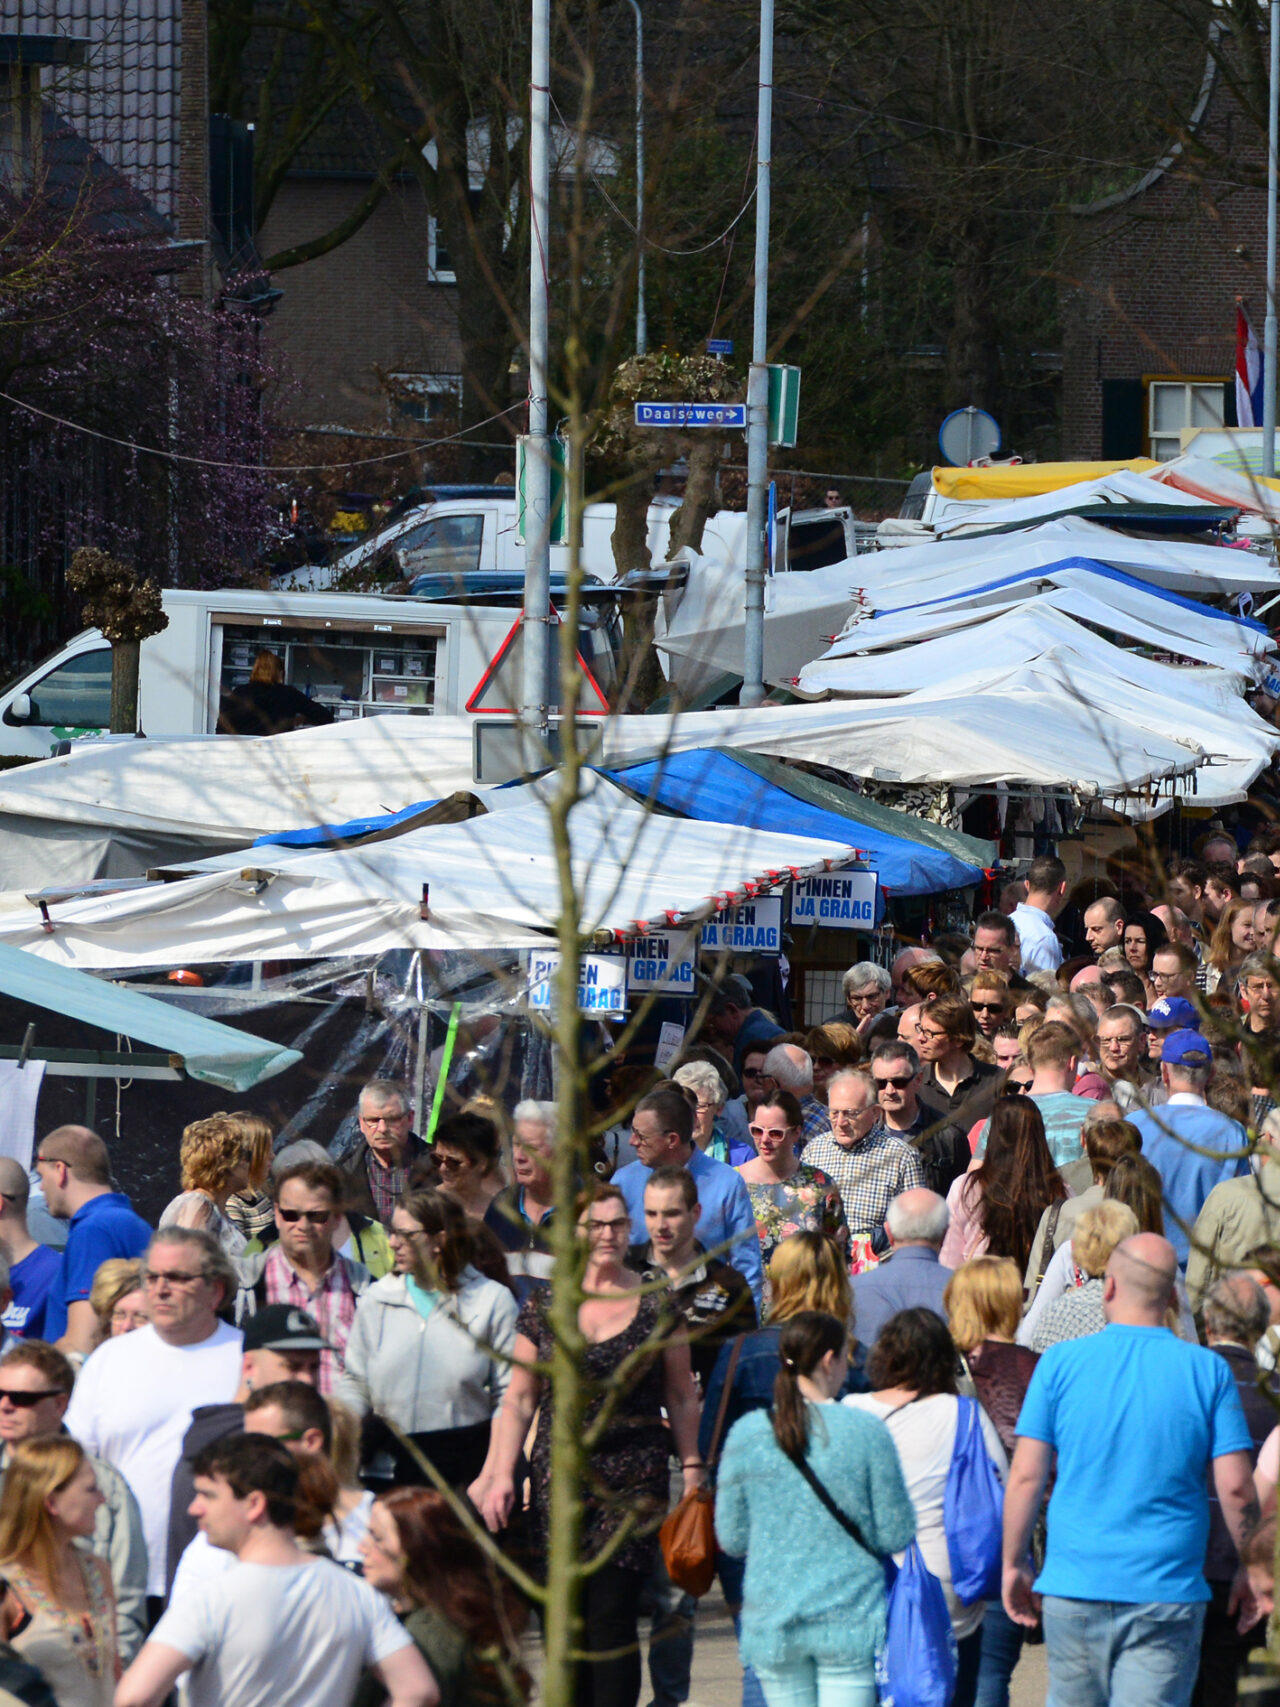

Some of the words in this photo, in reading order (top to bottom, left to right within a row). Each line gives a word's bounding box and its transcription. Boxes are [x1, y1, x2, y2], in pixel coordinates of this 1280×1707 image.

[643, 407, 724, 422] Daalseweg
[796, 878, 852, 898] PINNEN
[795, 898, 815, 916] JA
[820, 899, 872, 920] GRAAG
[701, 925, 718, 944] JA
[722, 926, 777, 947] GRAAG
